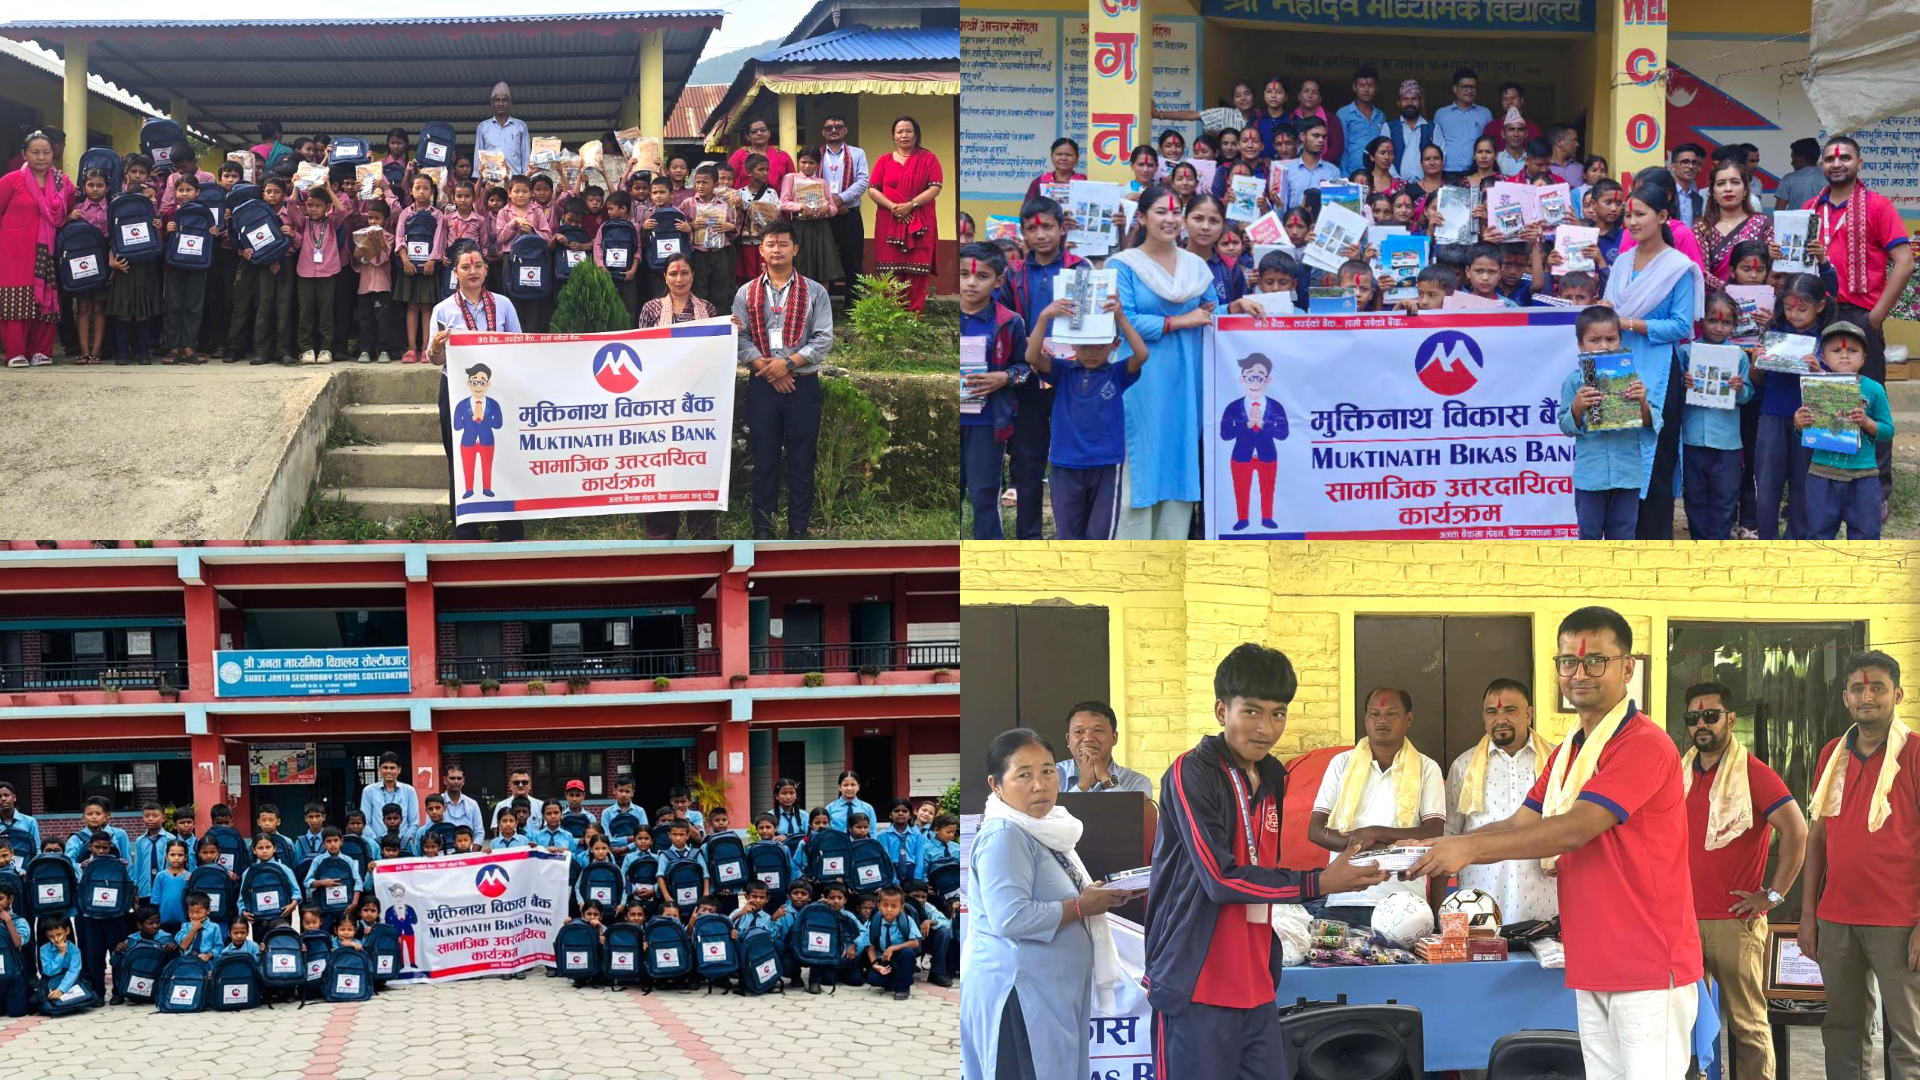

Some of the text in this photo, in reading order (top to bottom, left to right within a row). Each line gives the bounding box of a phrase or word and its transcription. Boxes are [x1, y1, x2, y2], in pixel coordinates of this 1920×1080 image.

[519, 391, 716, 428] मुक्तिनाथ विकास बैंक
[1310, 402, 1433, 438] मुक्तिनाथ
[1442, 399, 1530, 427] विकास
[1539, 397, 1560, 425] बैं
[519, 425, 717, 451] MUKTINATH BIKAS BANK
[529, 447, 708, 476] सामाजिक उत्तरदायित्व
[1311, 441, 1576, 469] MUKTINATH BIKAS BAN
[582, 473, 656, 492] कार्यक्रम
[1324, 470, 1573, 503] सामाजिक उत्तरदायित्व
[1398, 501, 1502, 526] कार्यक्रम
[243, 656, 254, 669] श्री
[257, 658, 281, 669] जनता
[283, 655, 324, 668] माध्यमिक
[326, 654, 359, 668] विद्यालय
[426, 893, 552, 923] मुक्तिनाथ विकास बैंक
[429, 913, 552, 939] MUKTINATH BIKAS BANK
[436, 927, 547, 955] सामाजिक उत्तरदायित्व
